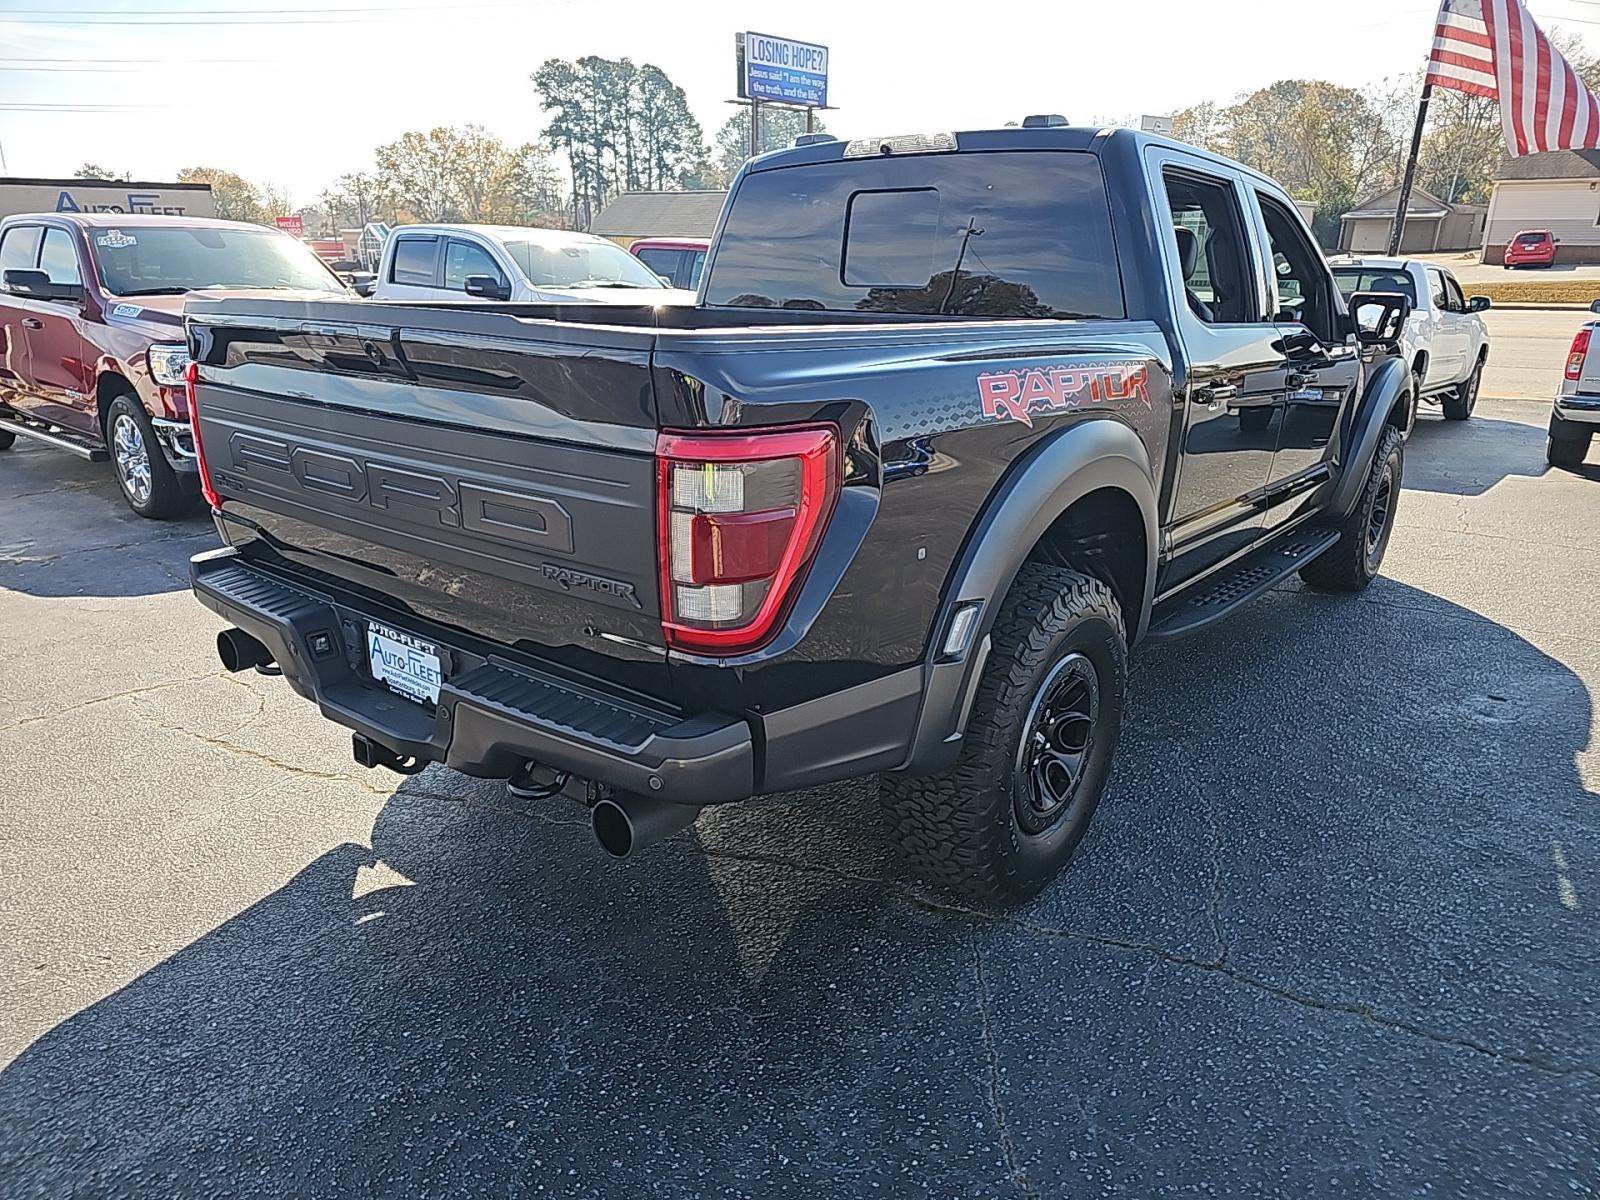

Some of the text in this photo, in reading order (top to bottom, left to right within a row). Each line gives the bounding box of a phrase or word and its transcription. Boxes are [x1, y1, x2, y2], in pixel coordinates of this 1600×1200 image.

[752, 38, 824, 71] LOSING HOPE?
[749, 67, 768, 79] Jesus
[768, 71, 783, 81] said
[790, 75, 800, 83] am
[801, 74, 812, 85] the
[753, 81, 765, 92] the
[783, 87, 797, 97] and
[797, 89, 808, 98] the
[977, 363, 1153, 429] RAPTOR
[228, 430, 576, 555] FORD
[541, 563, 643, 609] RAPTOR
[368, 621, 436, 655] AUTO-FLEET
[371, 636, 442, 685] AUTO-FLEET
